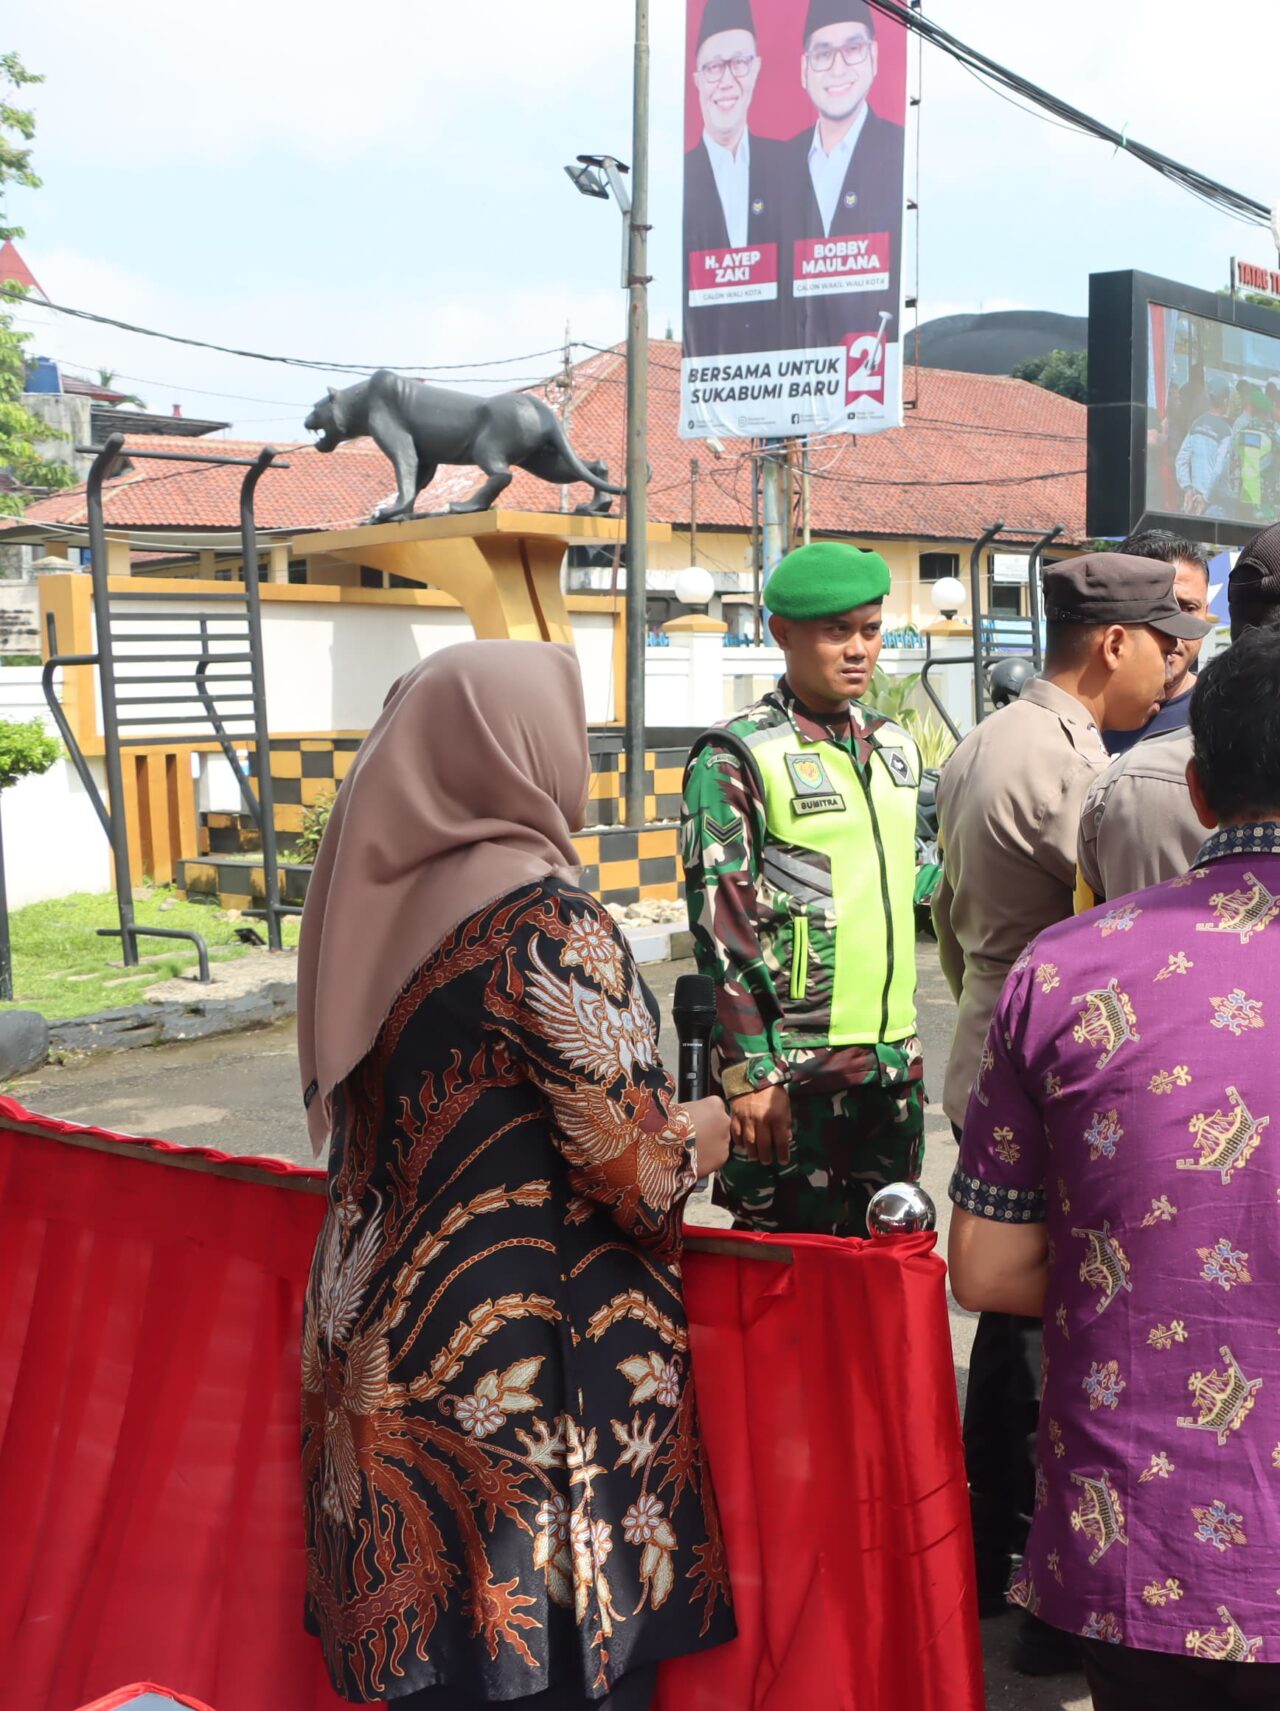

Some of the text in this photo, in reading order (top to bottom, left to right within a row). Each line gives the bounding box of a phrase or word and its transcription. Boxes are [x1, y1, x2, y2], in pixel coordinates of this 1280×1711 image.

[814, 240, 869, 258] BOBBY
[705, 251, 761, 270] H. AYEP
[802, 255, 880, 274] MAULANA
[715, 267, 750, 283] ZAKI
[688, 357, 840, 383] BERSAMA UNTUK
[848, 335, 882, 392] 2
[691, 380, 840, 404] SUKABUMI BARU
[801, 799, 838, 809] SUMITRA
